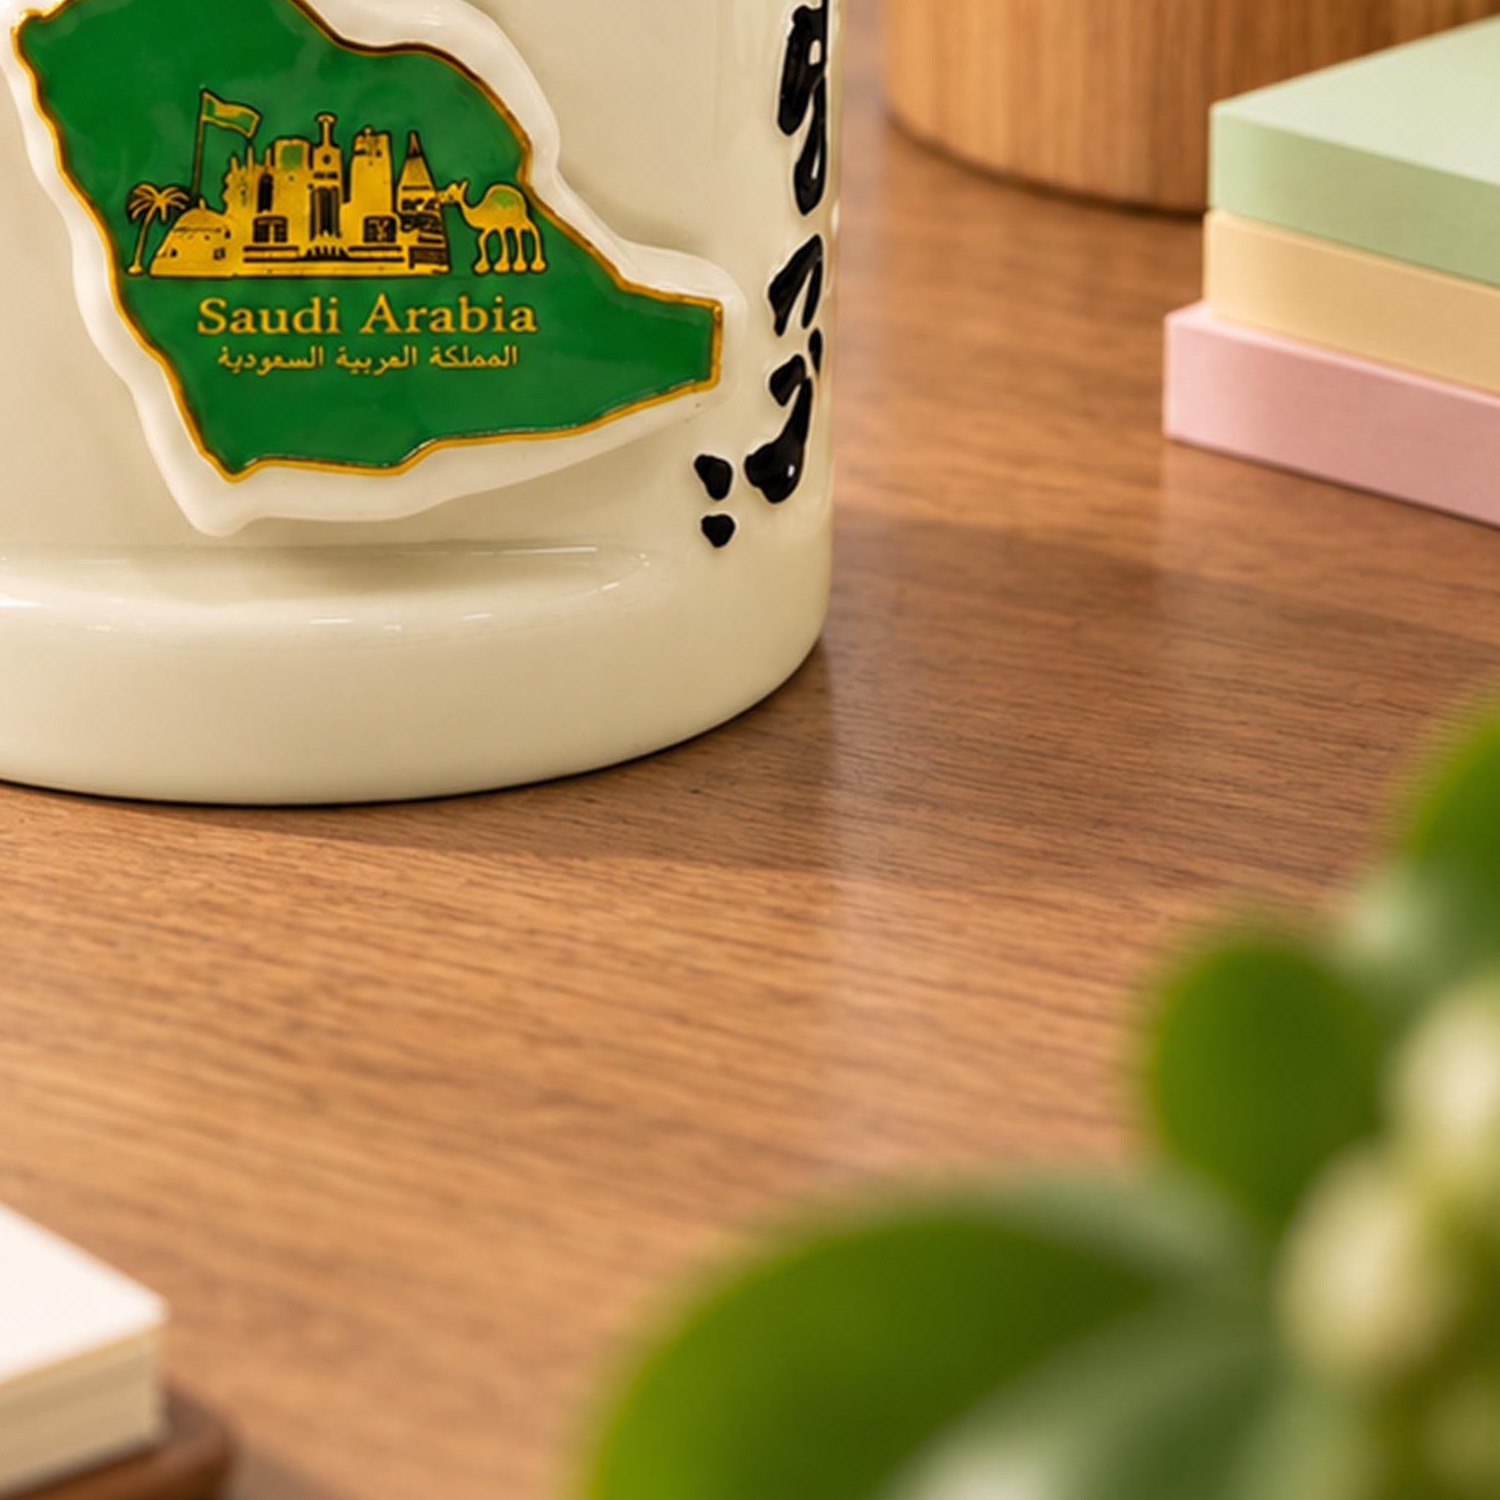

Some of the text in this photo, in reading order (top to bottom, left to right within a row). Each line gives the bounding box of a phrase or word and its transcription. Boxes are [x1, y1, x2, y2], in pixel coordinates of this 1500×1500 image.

[196, 292, 538, 335] Saudi Arabia
[217, 344, 518, 377] المملكة العربية السعودية
